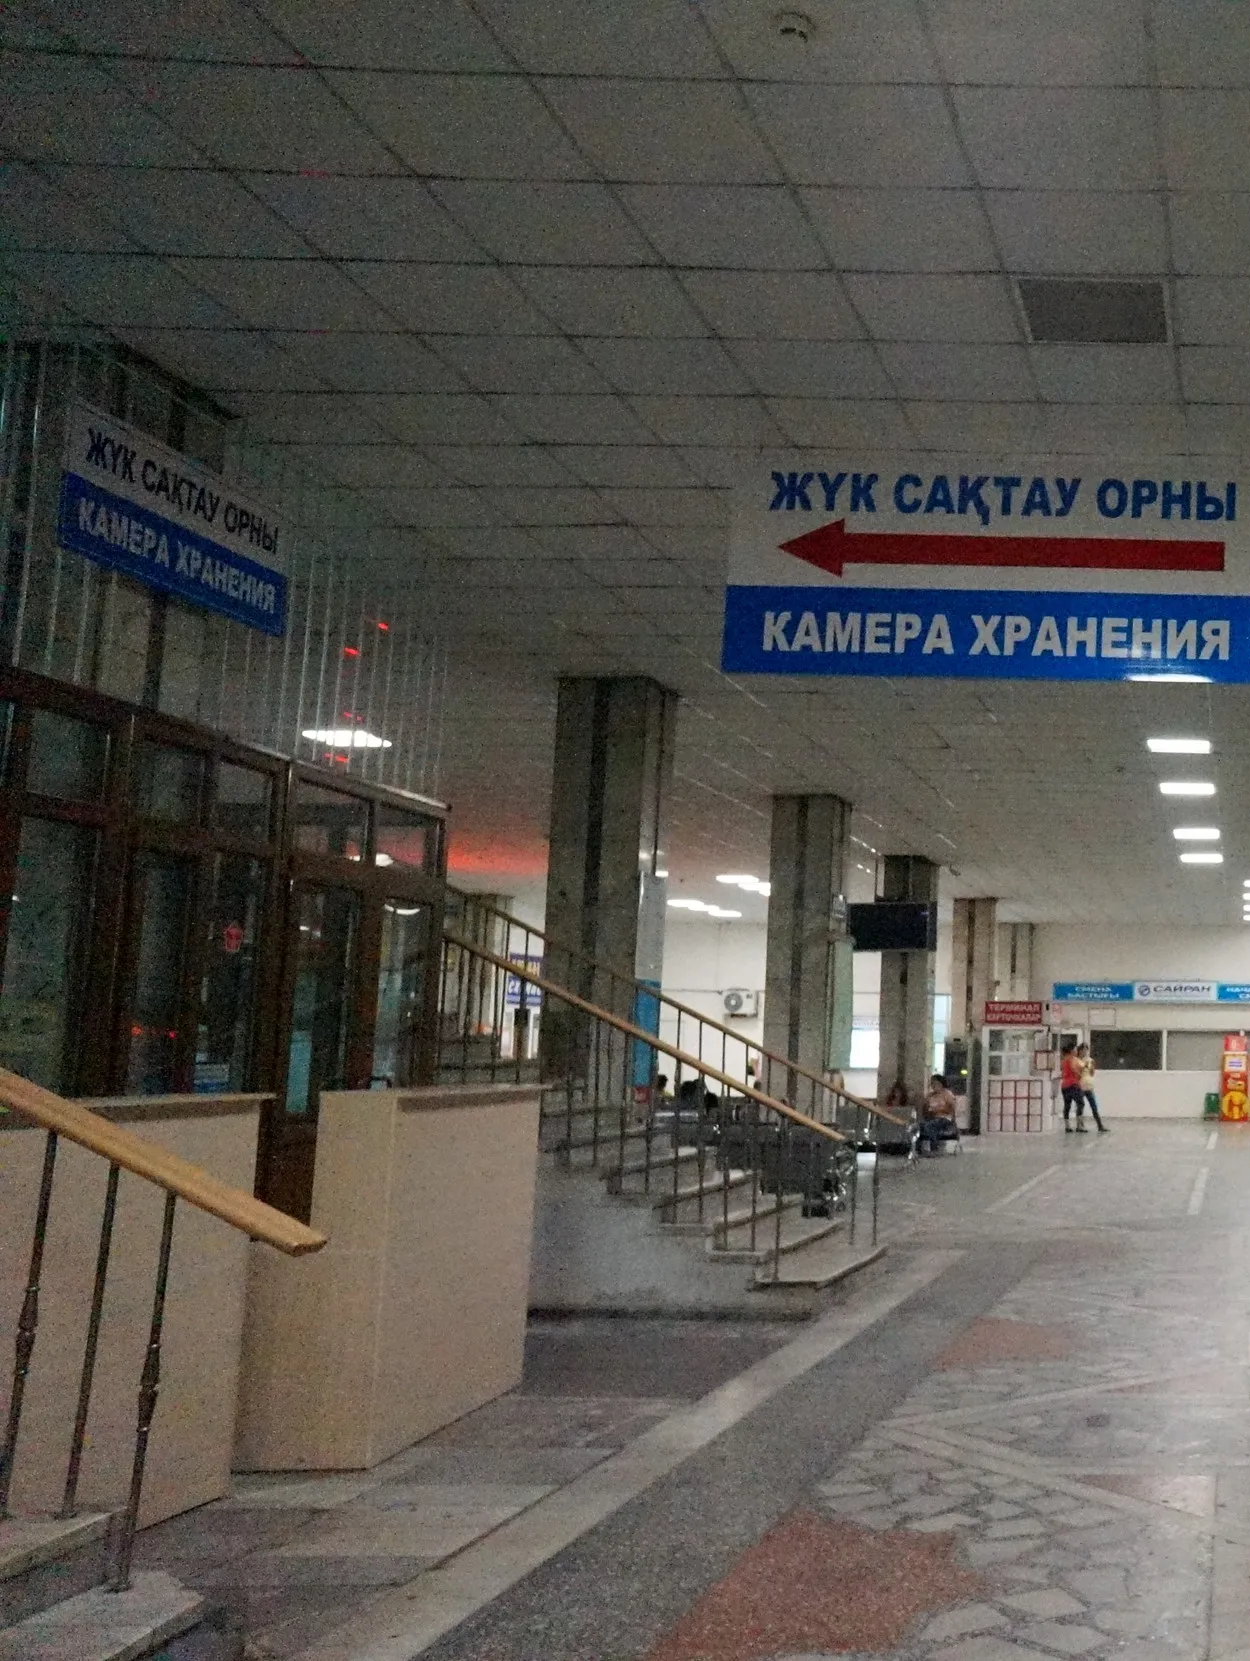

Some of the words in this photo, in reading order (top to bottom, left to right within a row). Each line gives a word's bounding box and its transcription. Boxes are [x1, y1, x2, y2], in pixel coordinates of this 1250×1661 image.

[769, 471, 880, 512] ЖҮК
[893, 473, 1081, 525] САҚТАУ
[1096, 479, 1236, 521] ОРНЫ
[223, 502, 278, 553] ОРНЫ
[78, 497, 170, 568] КАМЕРА
[176, 541, 275, 614] ХРАНЕНИЯ
[762, 611, 954, 655] КАМЕРА
[969, 614, 1231, 661] ХРАНЕНИЯ
[1153, 985, 1211, 993] САЙРАН
